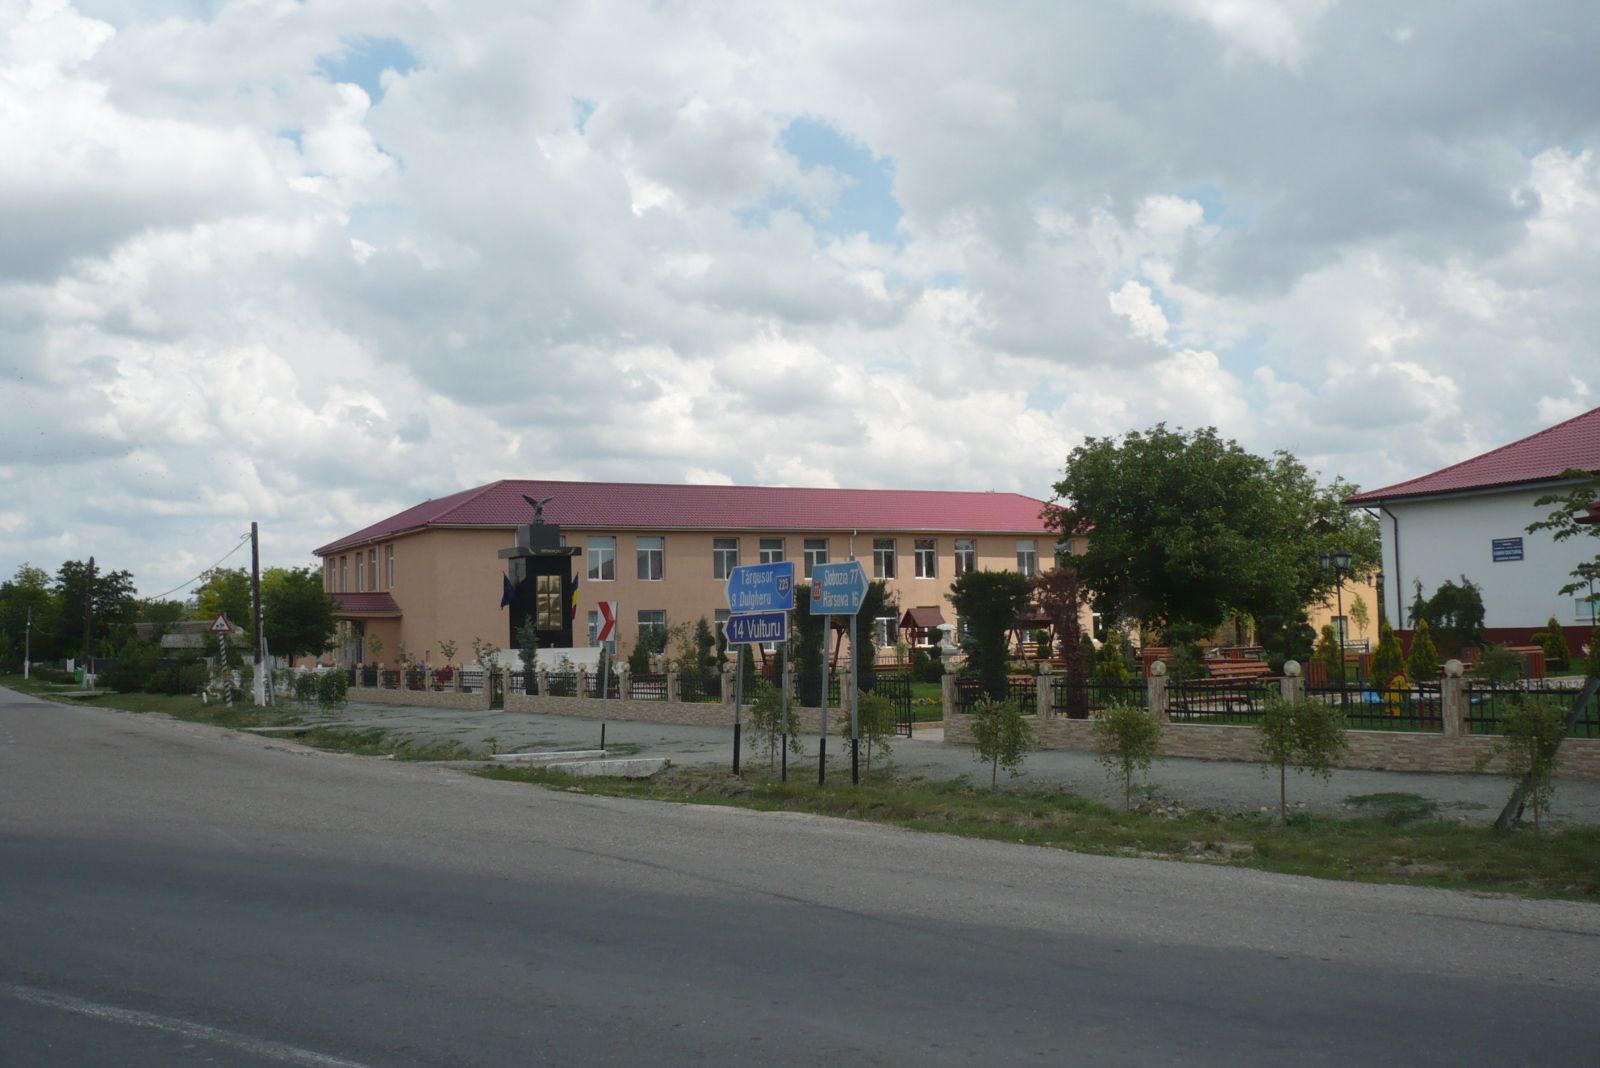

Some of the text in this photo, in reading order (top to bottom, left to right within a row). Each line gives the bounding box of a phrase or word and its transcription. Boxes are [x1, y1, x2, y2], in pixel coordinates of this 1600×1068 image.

[778, 578, 789, 591] 225
[823, 568, 859, 587] Slobozia 77
[731, 590, 772, 610] 9 Dulgheru
[851, 590, 859, 607] 16
[733, 618, 781, 640] 14 Vulturu
